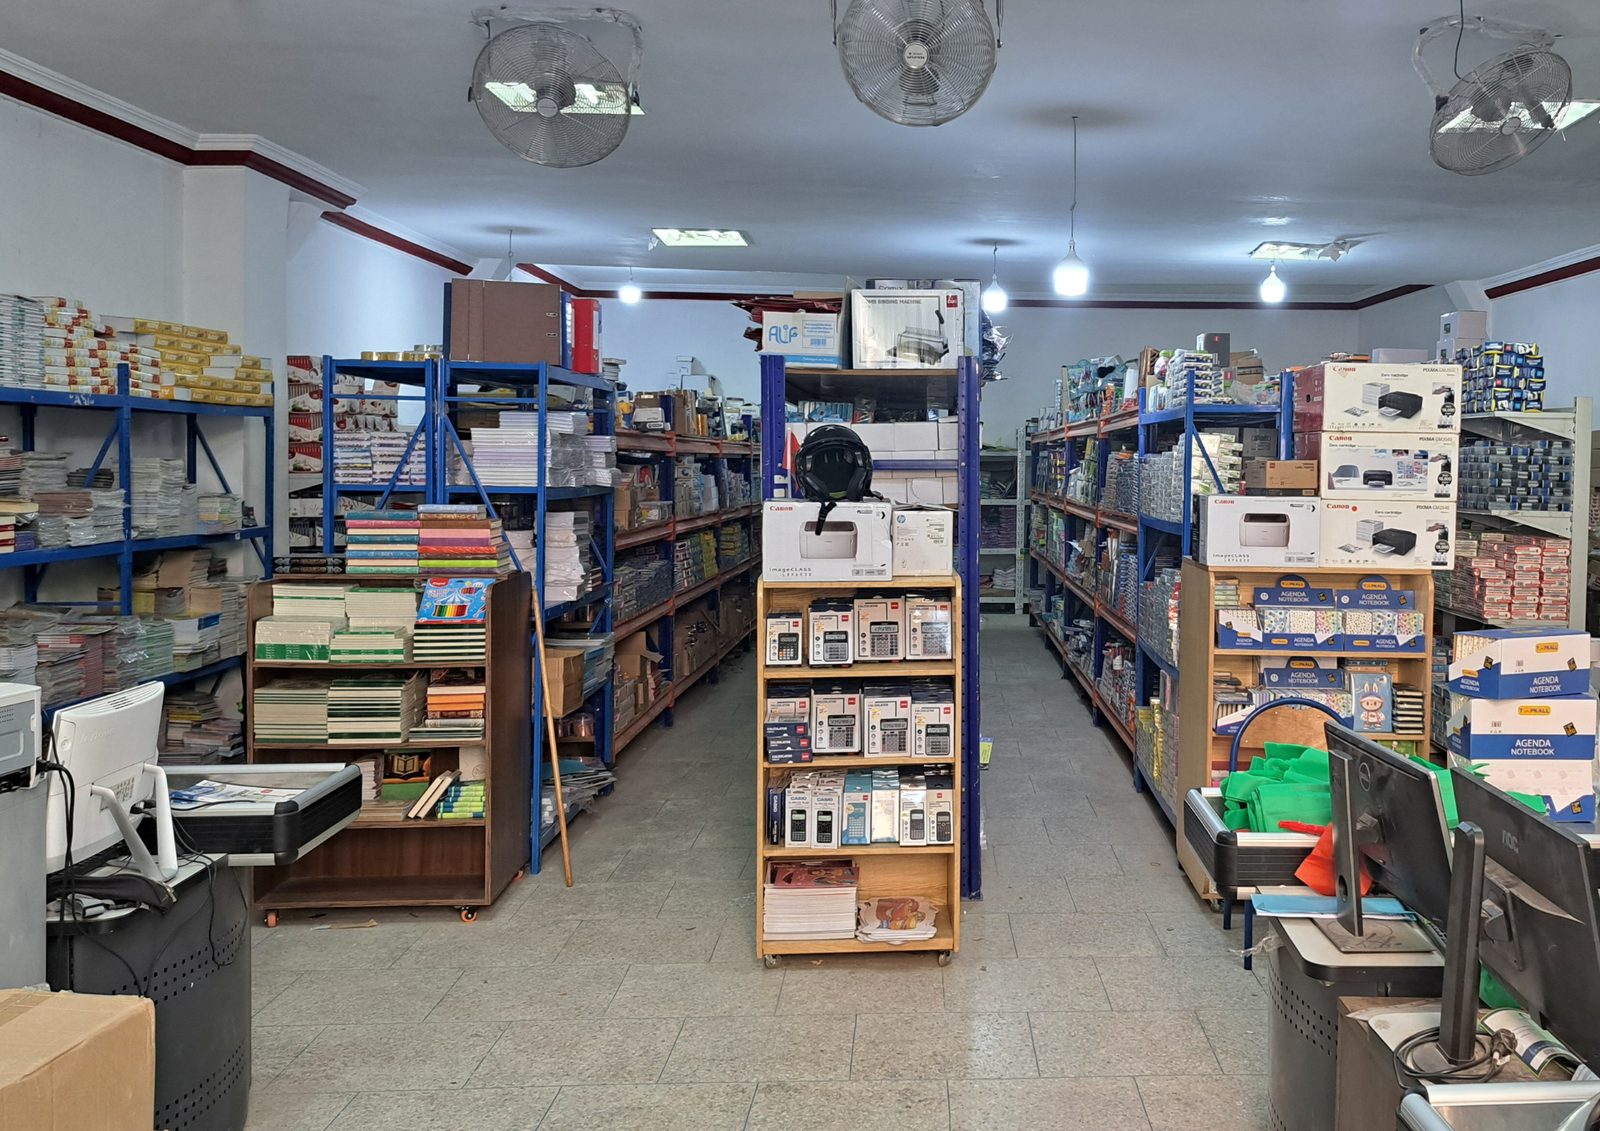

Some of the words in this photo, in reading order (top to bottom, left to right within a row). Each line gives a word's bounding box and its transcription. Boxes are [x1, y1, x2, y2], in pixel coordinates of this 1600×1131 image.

[1460, 678, 1480, 686] AGENDA
[1533, 676, 1559, 685] AGENDA
[1529, 684, 1561, 693] NOTEBOOK
[1515, 739, 1551, 748] AGENDA
[1511, 748, 1555, 756] NOTEBOOK
